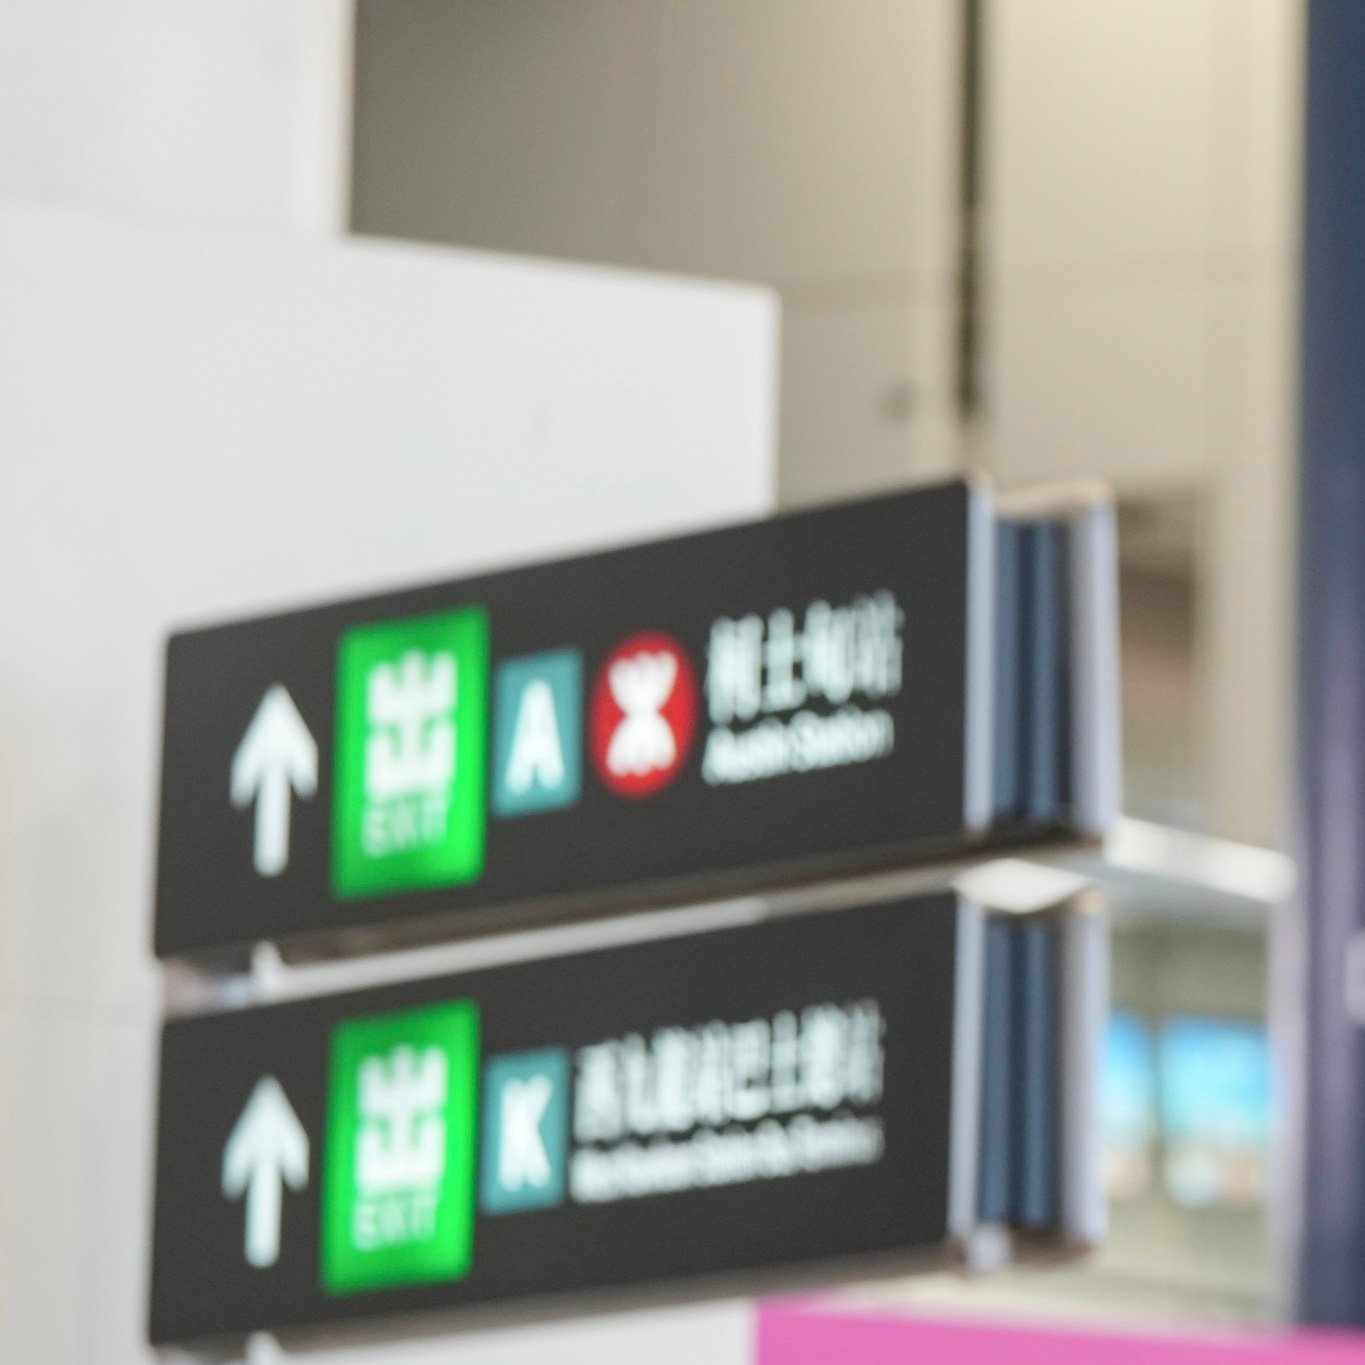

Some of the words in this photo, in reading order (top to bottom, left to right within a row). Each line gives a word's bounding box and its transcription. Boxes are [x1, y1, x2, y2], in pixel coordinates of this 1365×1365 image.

[366, 649, 457, 800] 出
[506, 679, 565, 793] A
[362, 800, 451, 858] EXIT
[356, 1044, 447, 1195] 出
[501, 1075, 552, 1191] K
[354, 1196, 439, 1252] EXIT
